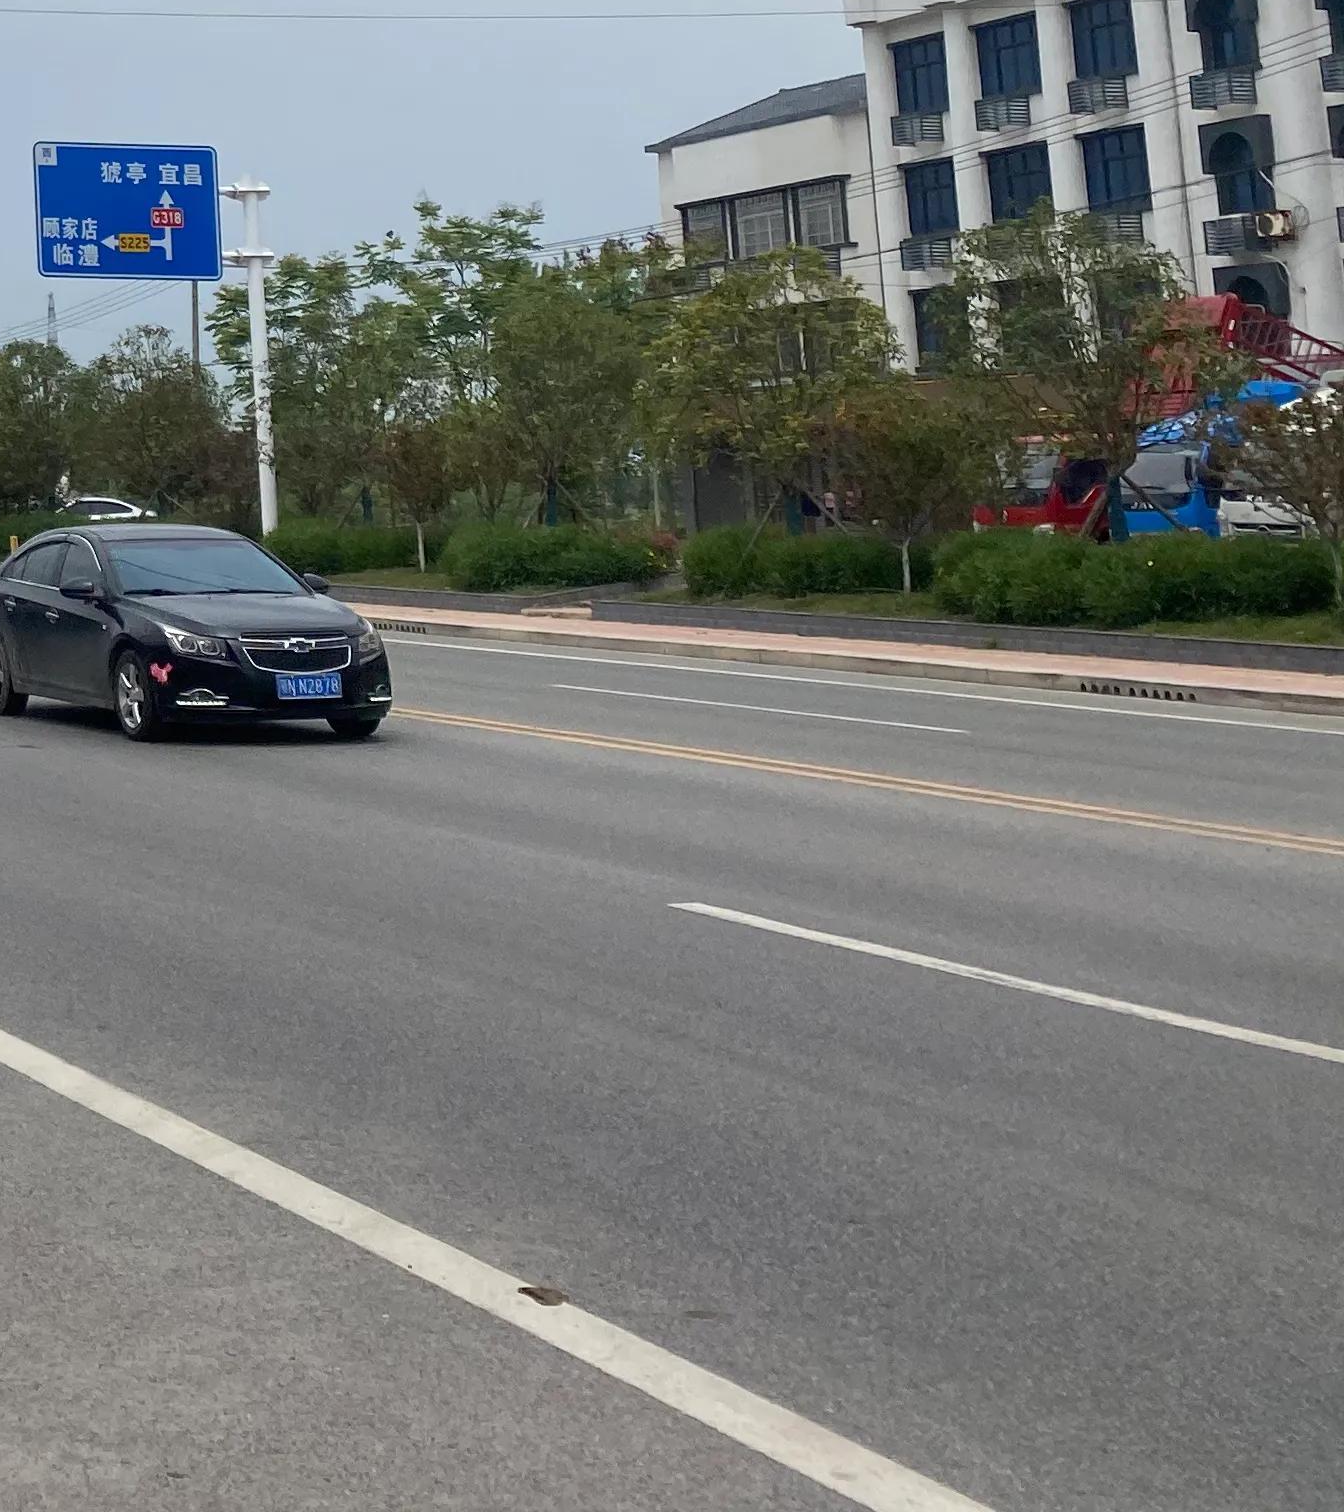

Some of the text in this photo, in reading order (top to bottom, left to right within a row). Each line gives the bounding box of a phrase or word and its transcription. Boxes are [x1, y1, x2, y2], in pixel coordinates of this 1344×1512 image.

[100, 161, 203, 186] 猇亭 宜昌
[42, 217, 98, 241] 顾家店
[153, 211, 182, 224] G318
[52, 243, 100, 267] 临澧
[120, 236, 150, 250] S225
